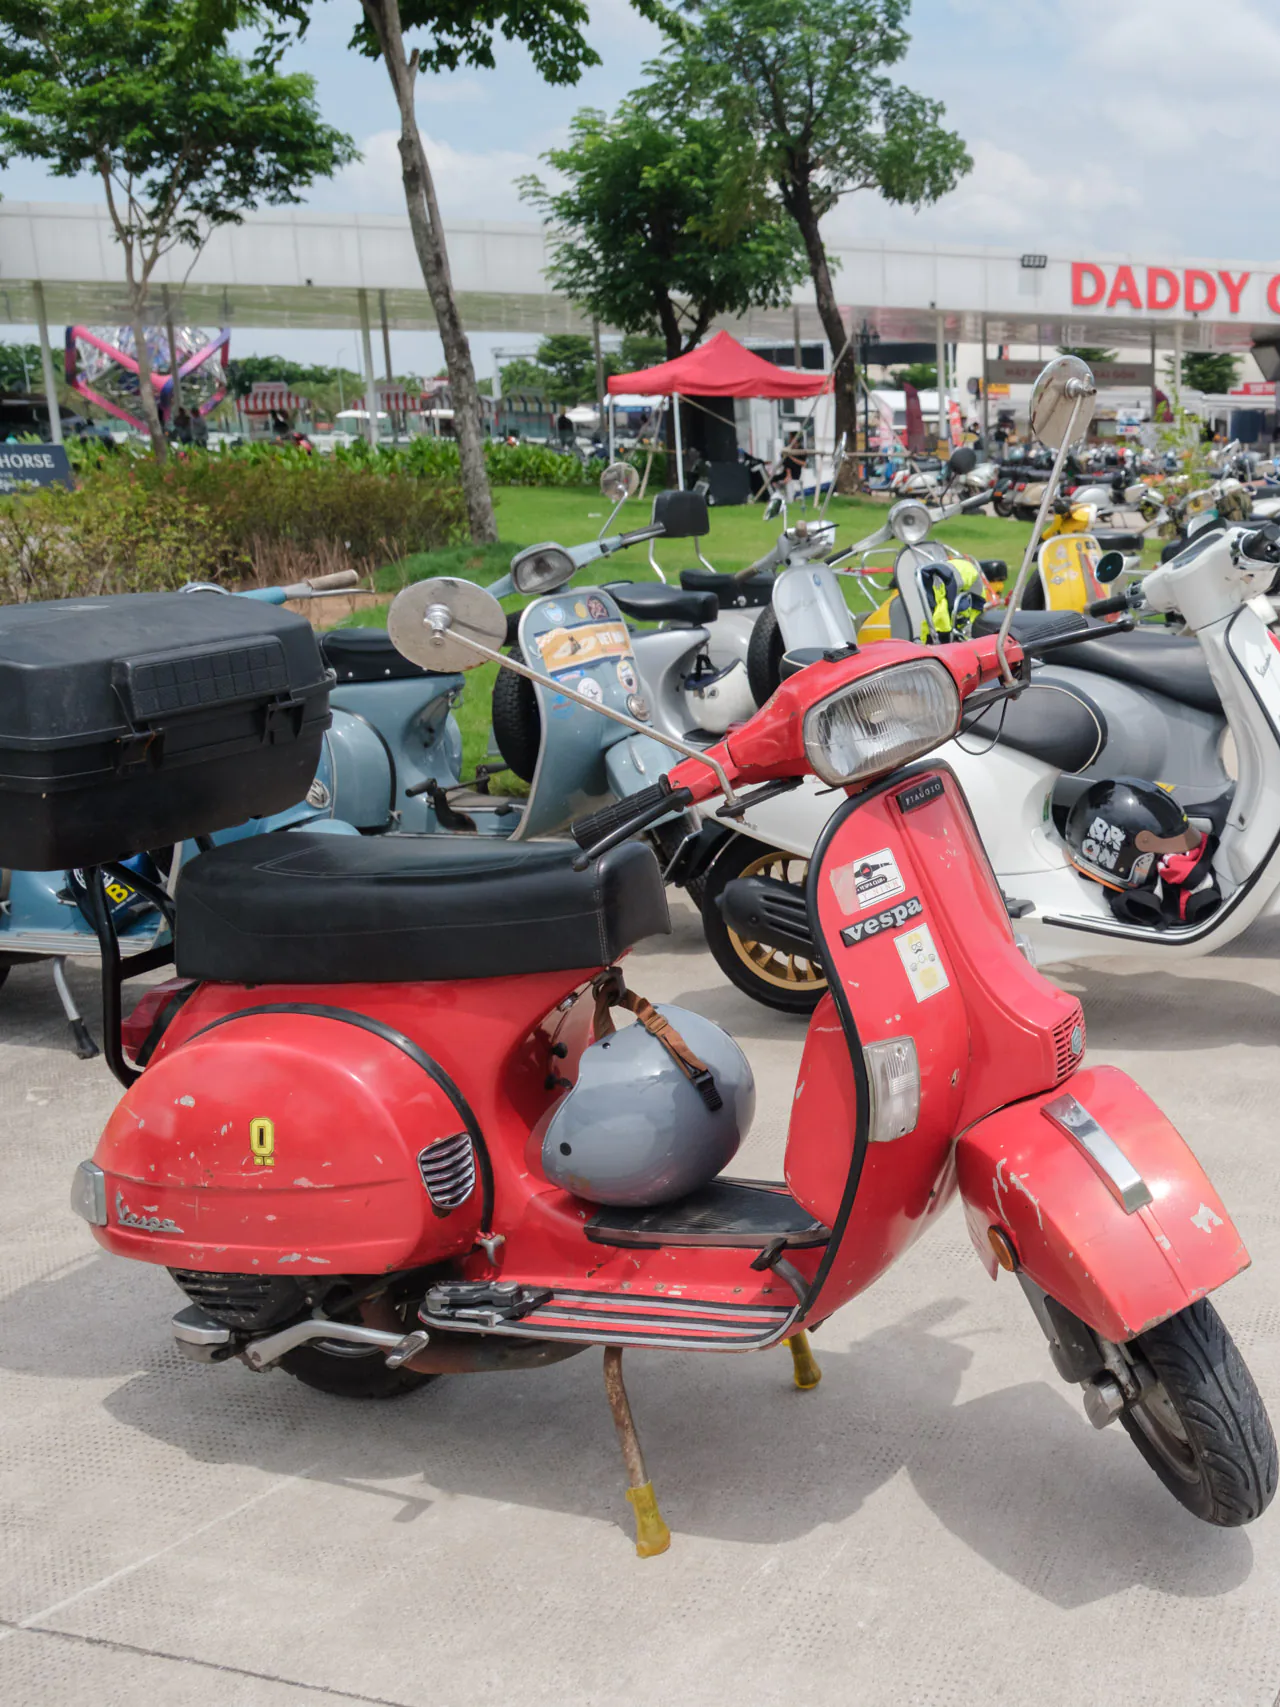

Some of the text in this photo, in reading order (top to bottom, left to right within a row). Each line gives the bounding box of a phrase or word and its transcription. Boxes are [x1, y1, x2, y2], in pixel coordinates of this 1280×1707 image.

[1071, 262, 1250, 313] DADDY
[0, 453, 55, 469] HORSE
[845, 898, 923, 942] vespa
[115, 1185, 184, 1233] Vespa
